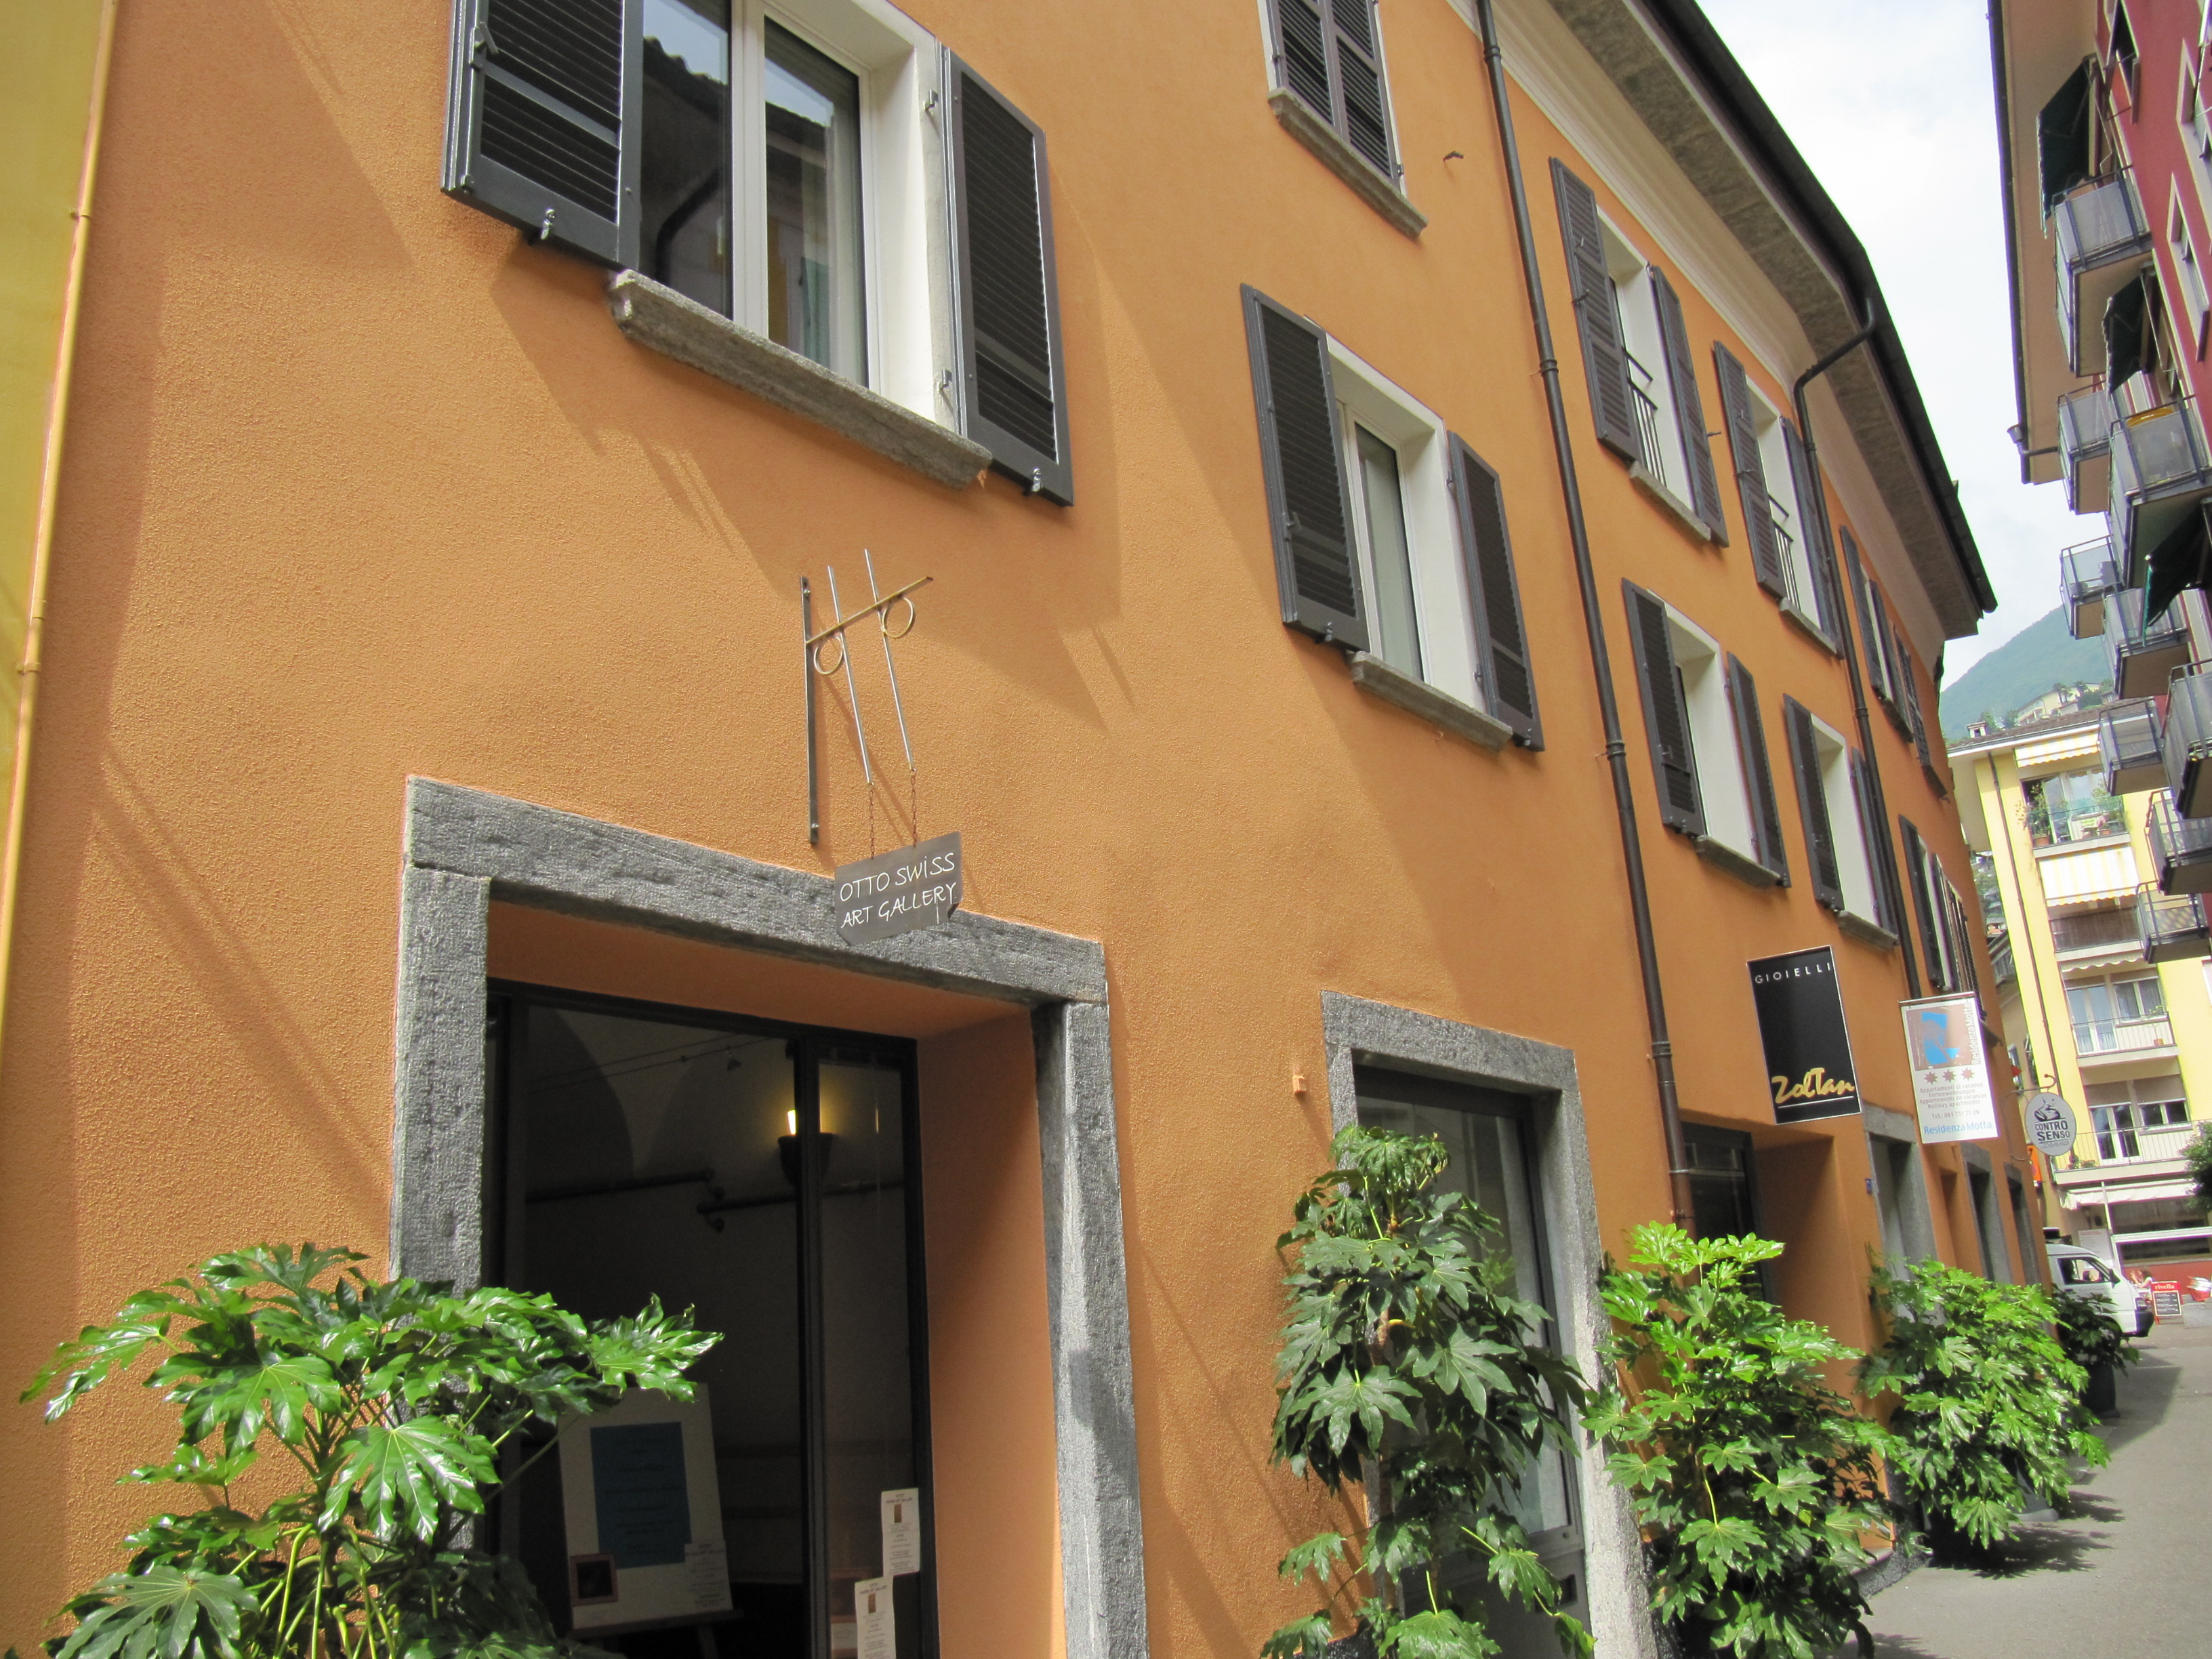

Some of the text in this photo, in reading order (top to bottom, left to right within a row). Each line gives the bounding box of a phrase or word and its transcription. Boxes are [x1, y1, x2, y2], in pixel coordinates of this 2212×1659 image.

[840, 872, 890, 901] OTTO
[840, 882, 956, 928] ART GALLERY
[1755, 962, 1830, 983] GIOIELLI
[2034, 1120, 2068, 1131] CONTRO
[2036, 1130, 2070, 1141] SENSO
